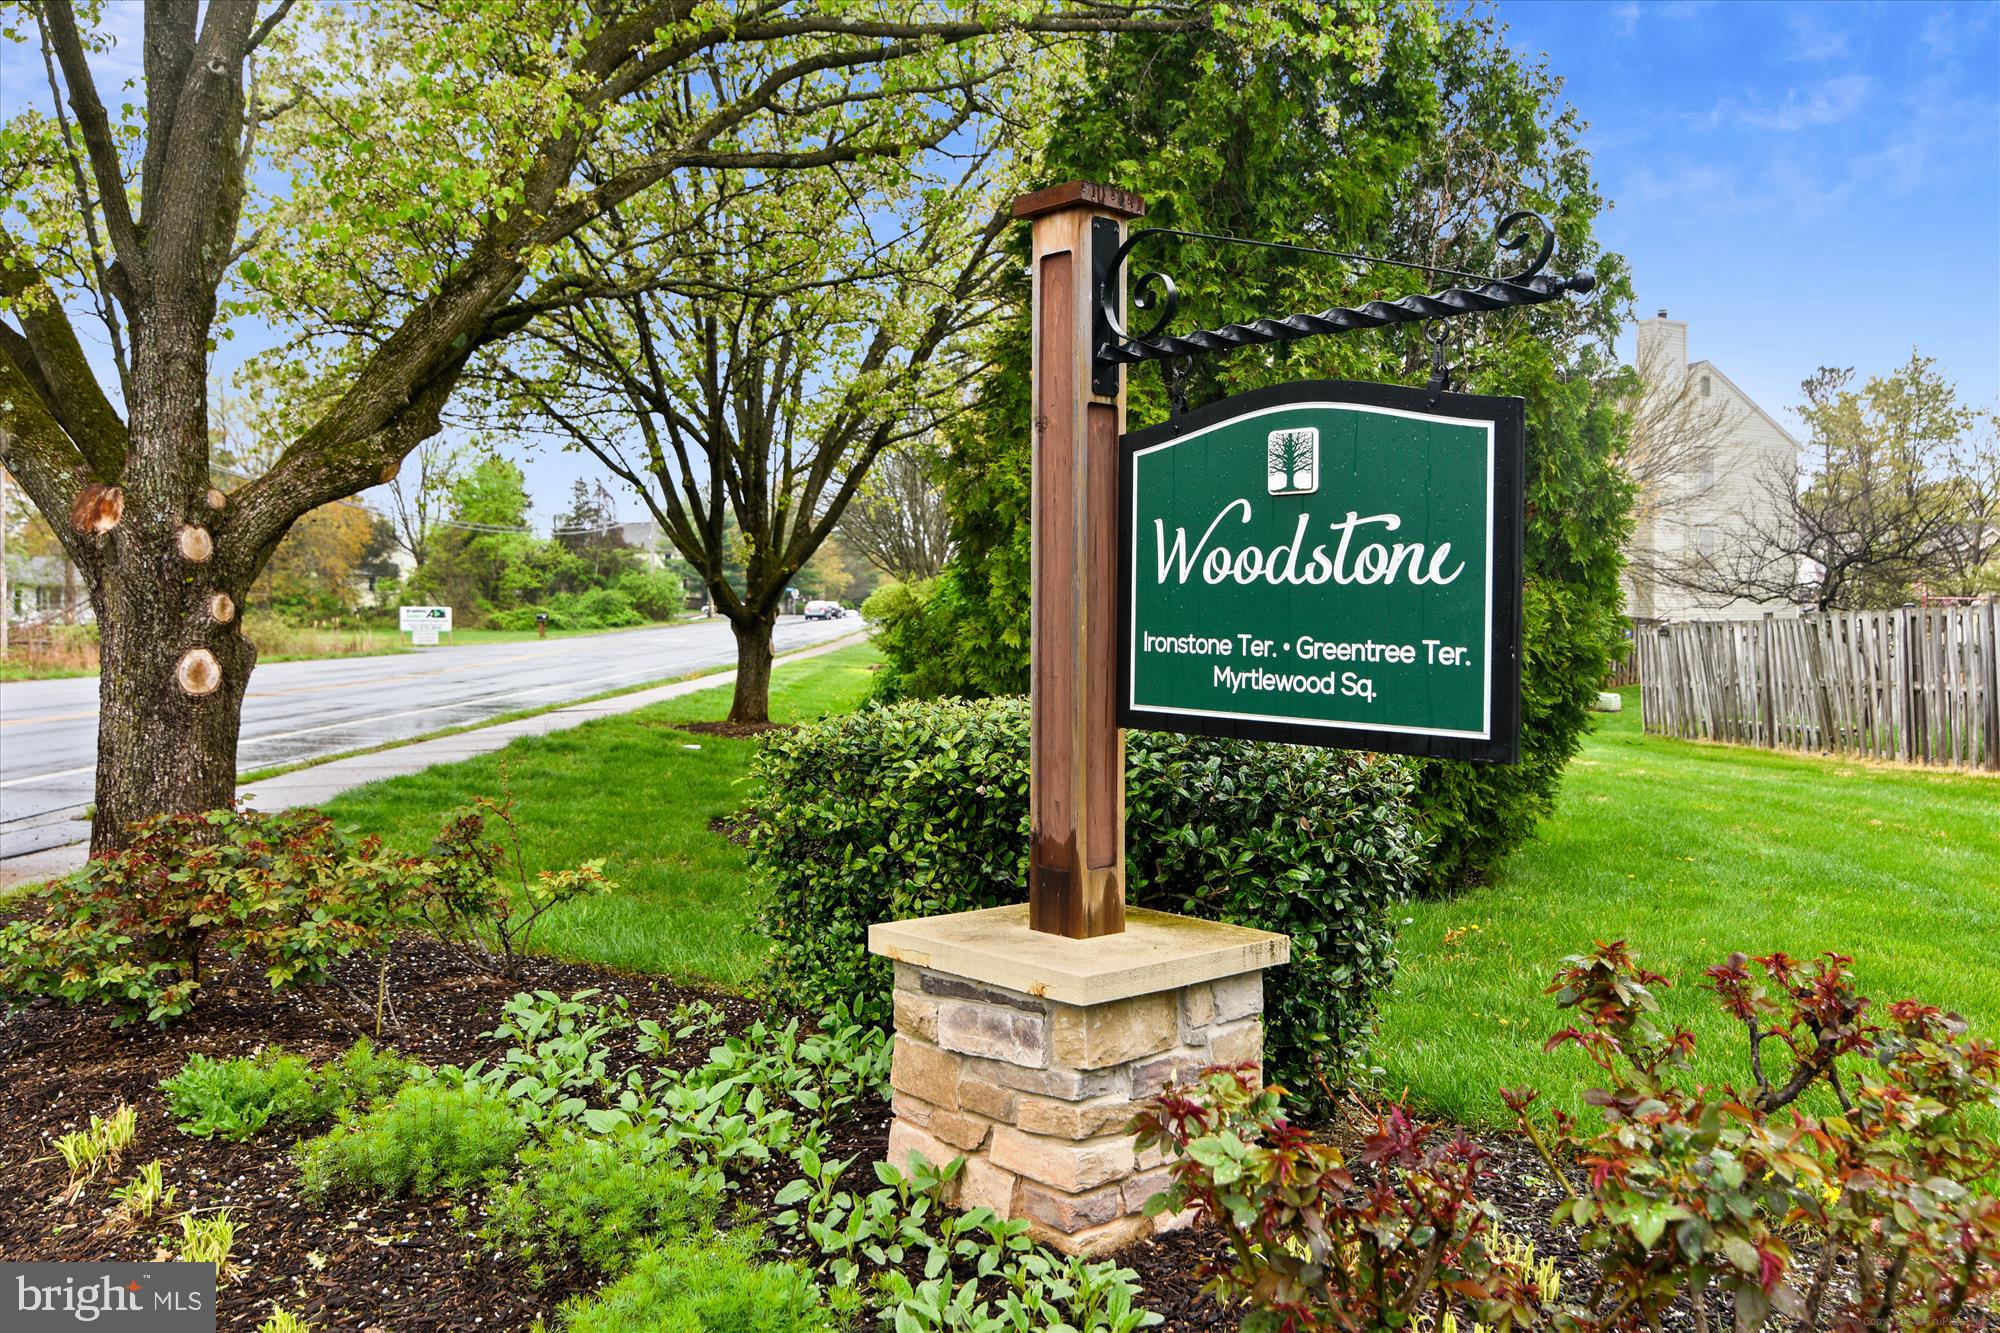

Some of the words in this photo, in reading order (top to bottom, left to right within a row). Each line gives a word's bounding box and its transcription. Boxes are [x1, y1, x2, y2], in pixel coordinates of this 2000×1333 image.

[1154, 498, 1465, 585] Woodstone
[1143, 630, 1233, 656] Ironstone
[1237, 633, 1277, 658] Ter.
[1296, 635, 1416, 664] Greentree
[1421, 639, 1472, 667] Ter.
[1213, 664, 1335, 695] Myrtlewood
[1340, 671, 1377, 703] Sq.
